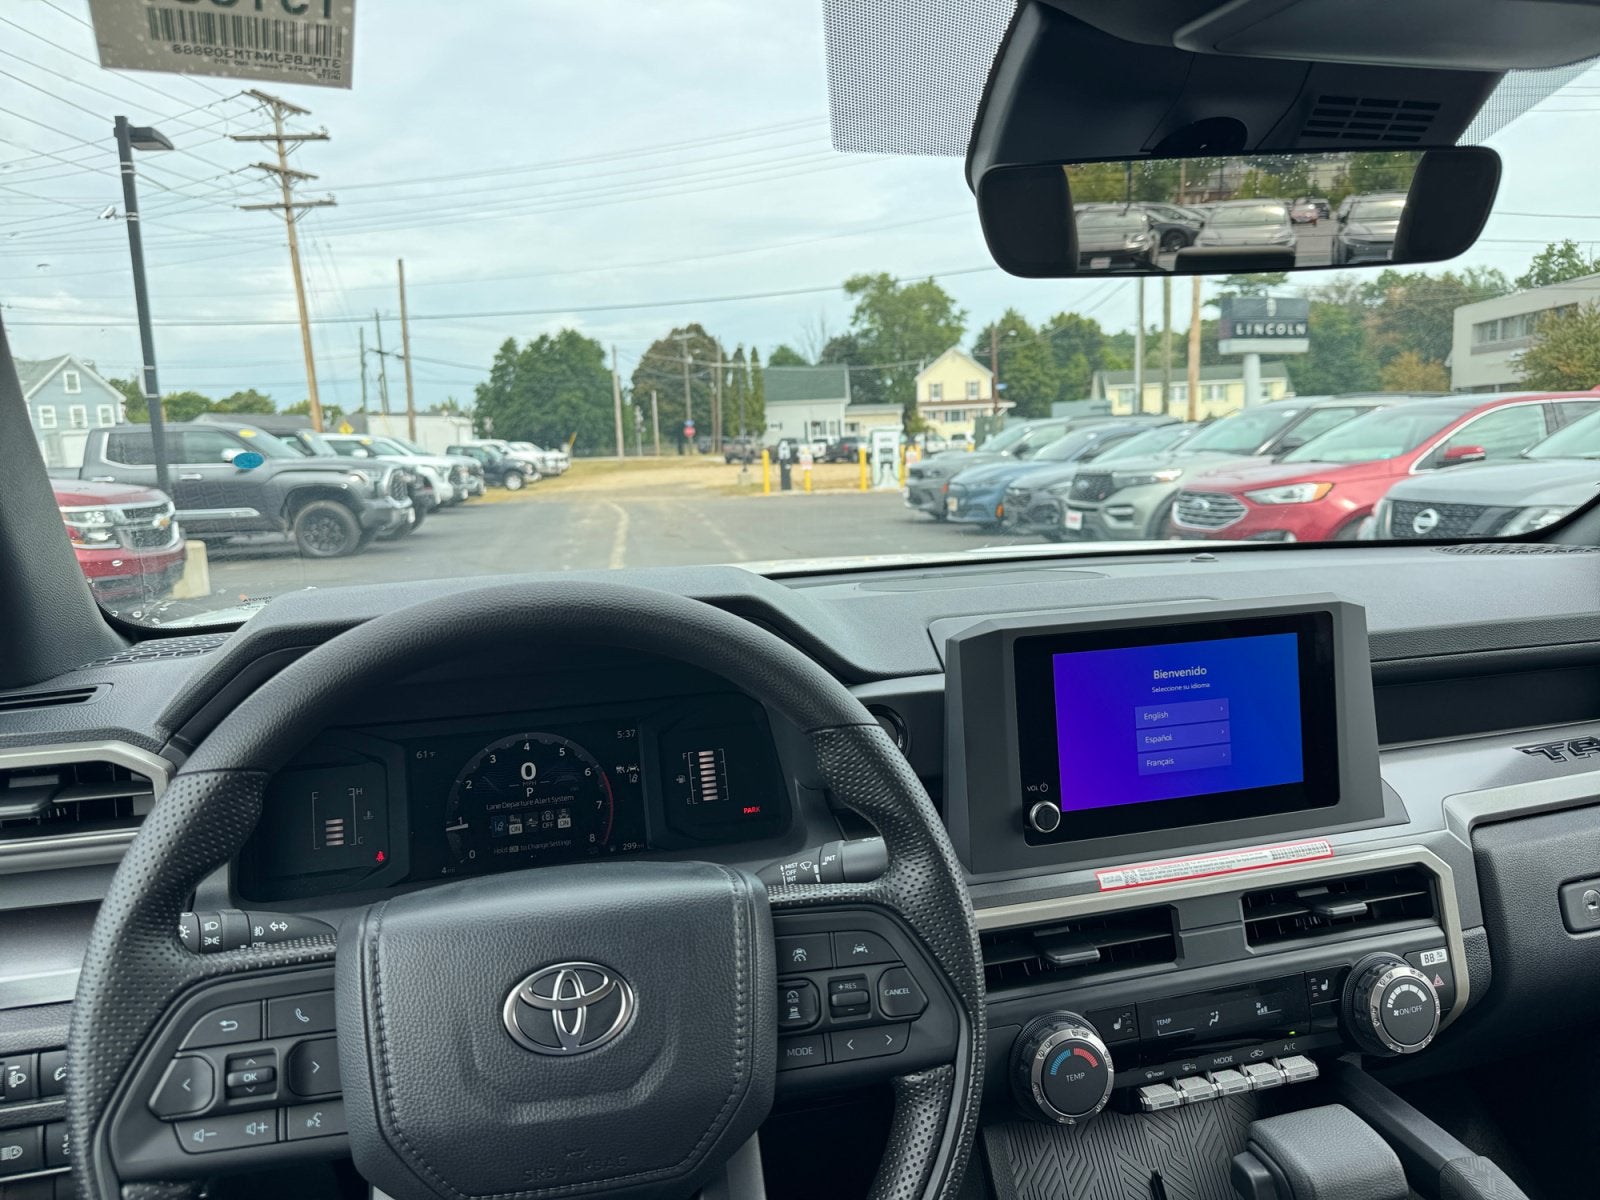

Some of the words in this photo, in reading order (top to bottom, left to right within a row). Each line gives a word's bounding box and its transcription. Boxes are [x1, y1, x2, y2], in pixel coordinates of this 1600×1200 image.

[1235, 322, 1307, 336] LINCOLN
[1153, 665, 1207, 680] Bienvenido
[1151, 684, 1181, 693] Seleccione
[1191, 682, 1211, 690] idioma
[1143, 711, 1169, 722] English
[617, 729, 636, 739] 5:37
[1145, 733, 1173, 744] Español
[523, 742, 530, 751] 4
[559, 748, 566, 756] 5
[682, 752, 688, 760] F
[489, 755, 497, 763] 3
[1146, 757, 1175, 768] Français
[520, 762, 537, 781] 0
[584, 768, 592, 776] 6
[465, 780, 472, 789] 2
[1027, 784, 1038, 792] VOL
[526, 787, 534, 798] P
[502, 799, 534, 809] Departure
[534, 797, 551, 805] Alert
[551, 795, 575, 804] System
[596, 801, 603, 810] 7
[743, 806, 761, 814] PARK
[457, 816, 463, 824] 1
[542, 821, 554, 829] OFF
[589, 834, 596, 843] 8
[623, 842, 637, 850] 299
[468, 850, 476, 859] 0
[825, 854, 836, 862] INT
[441, 866, 447, 874] 4
[784, 862, 798, 870] MIST
[884, 987, 911, 997] CANCEL
[1399, 1004, 1423, 1016] ON/OFF
[1156, 1017, 1172, 1026] TEMP
[1283, 1042, 1296, 1051] A/C
[787, 1046, 813, 1057] MODE
[1213, 1055, 1233, 1065] MODE
[243, 1072, 258, 1082] OK
[1065, 1071, 1086, 1083] TEMP
